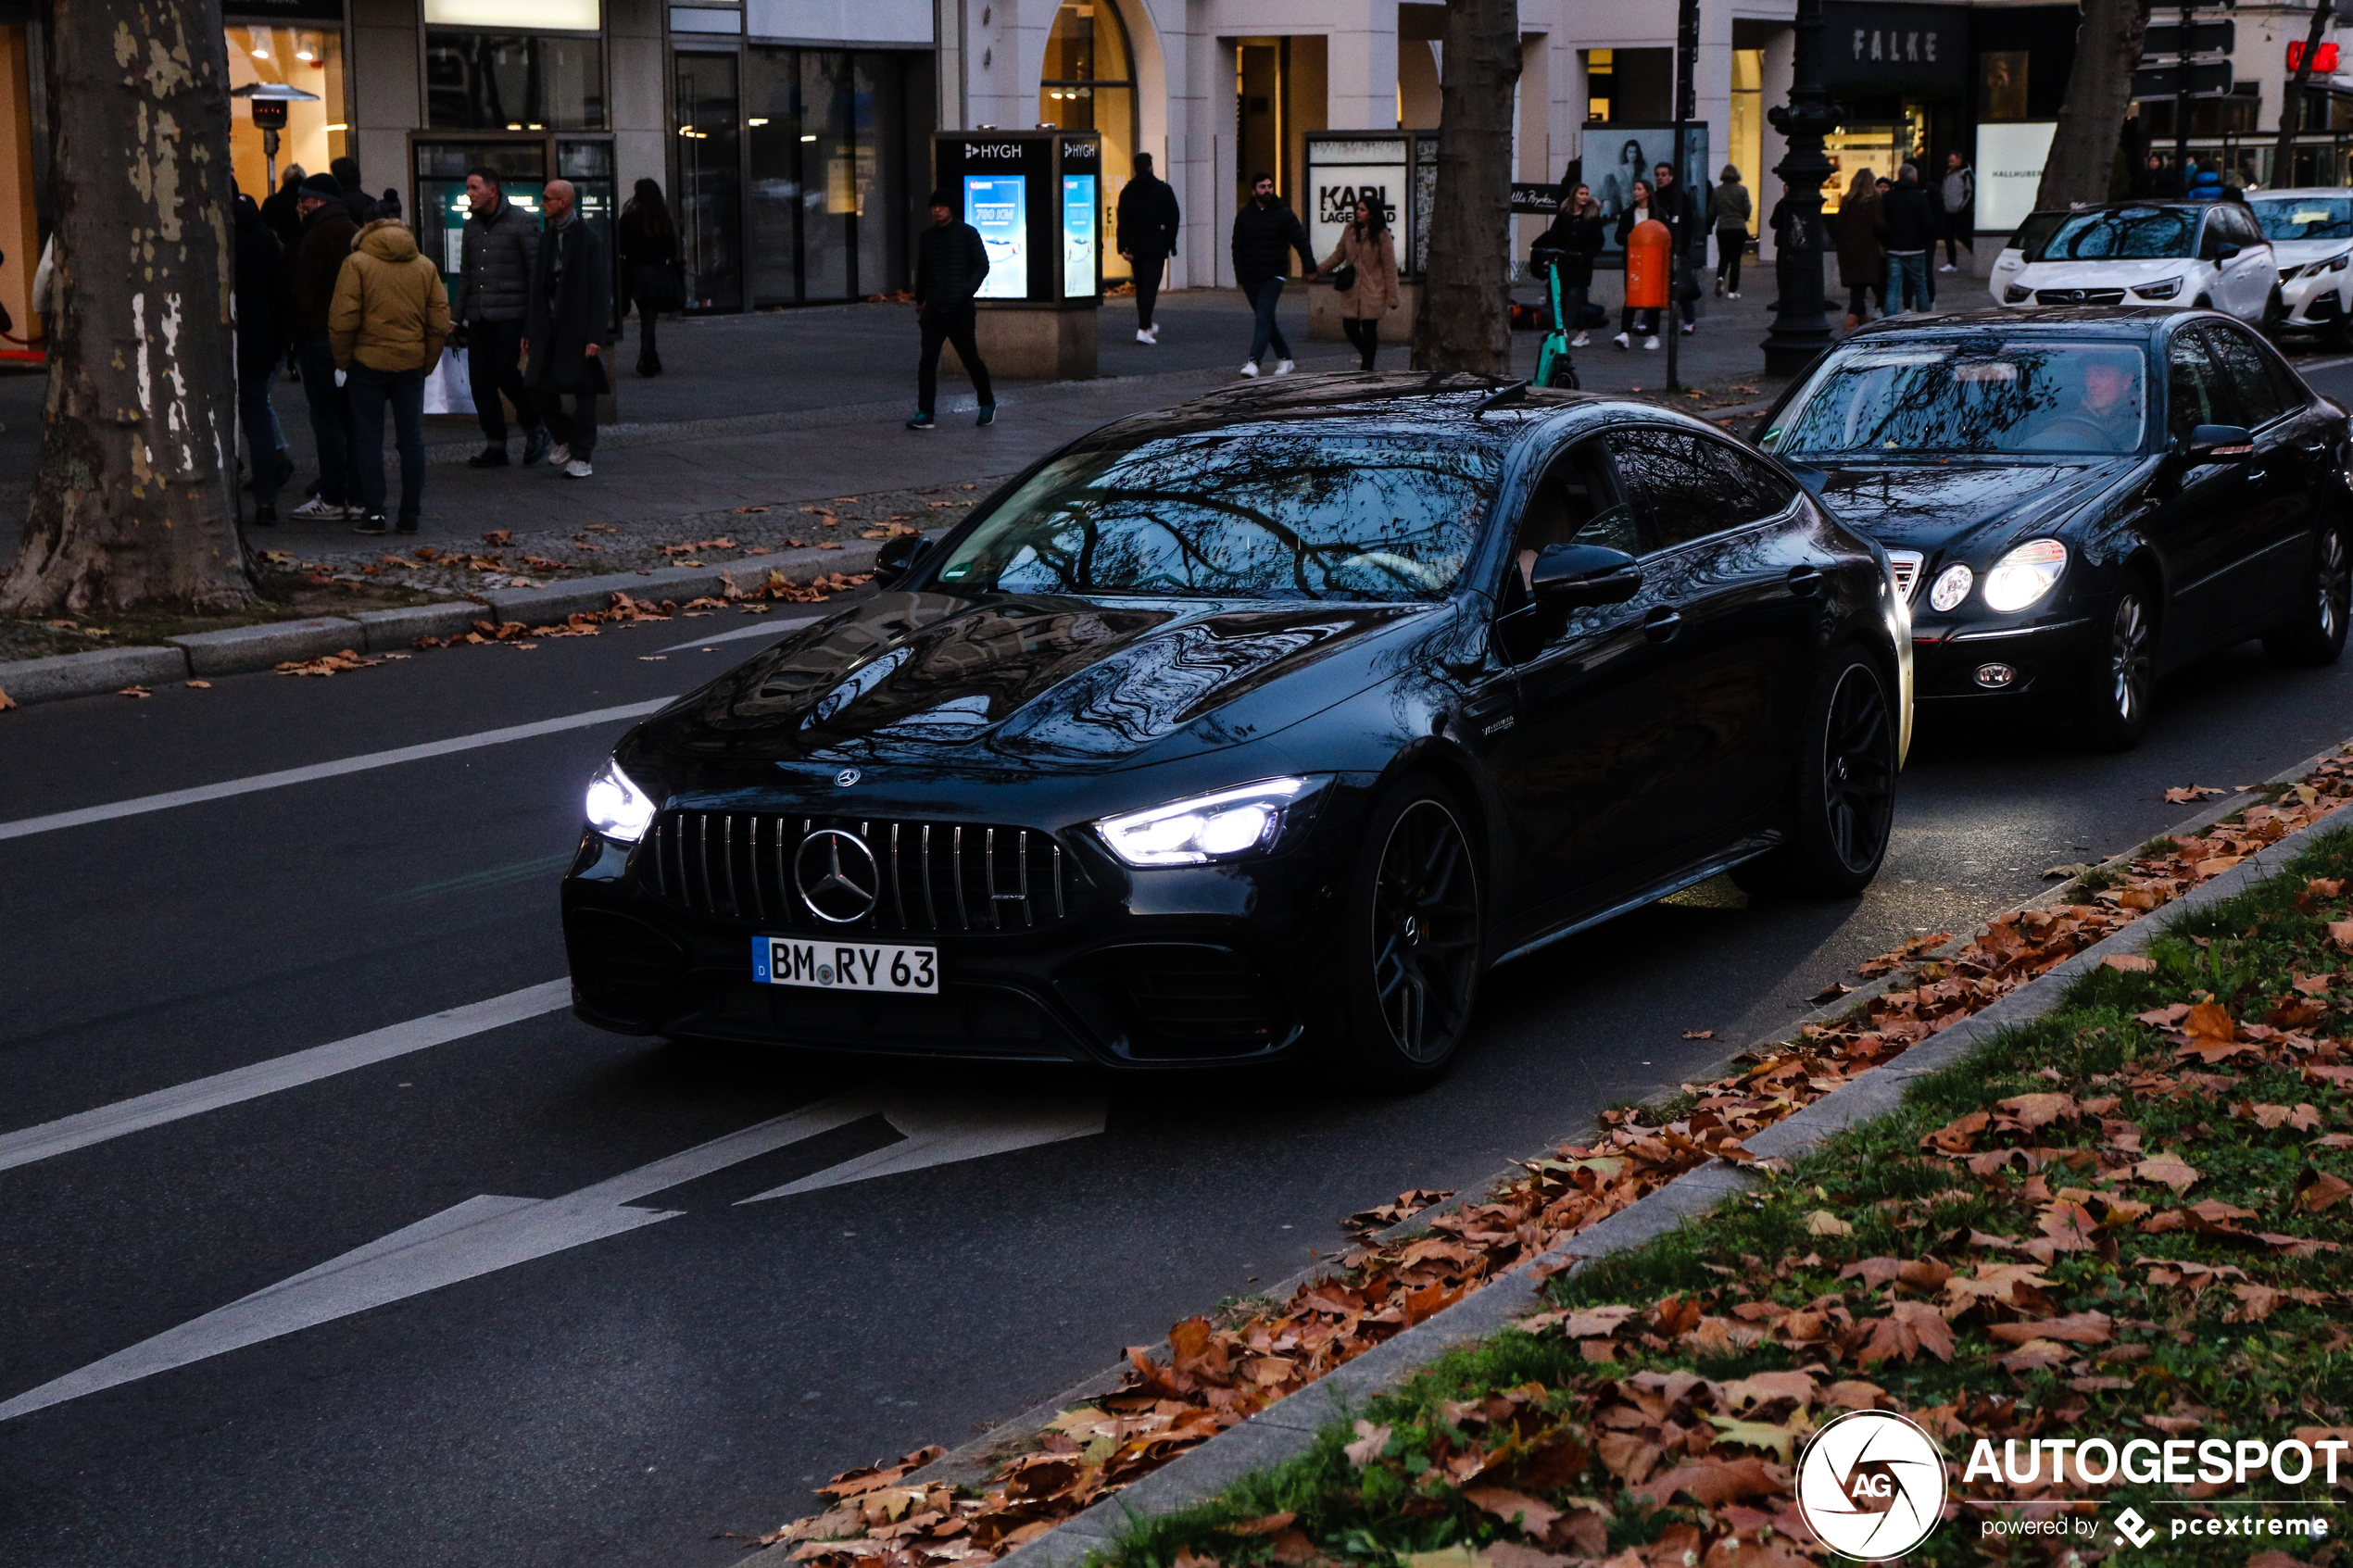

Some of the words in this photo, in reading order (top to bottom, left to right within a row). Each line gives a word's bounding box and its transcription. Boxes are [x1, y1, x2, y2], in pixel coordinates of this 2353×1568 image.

[1853, 29, 1938, 62] FALKE
[981, 144, 1022, 158] HYGH
[1072, 144, 1095, 157] HYGH
[1321, 211, 1396, 223] LAGED
[758, 965, 766, 976] D
[772, 943, 815, 982] BM
[836, 947, 880, 985] RY
[890, 950, 935, 987] 63
